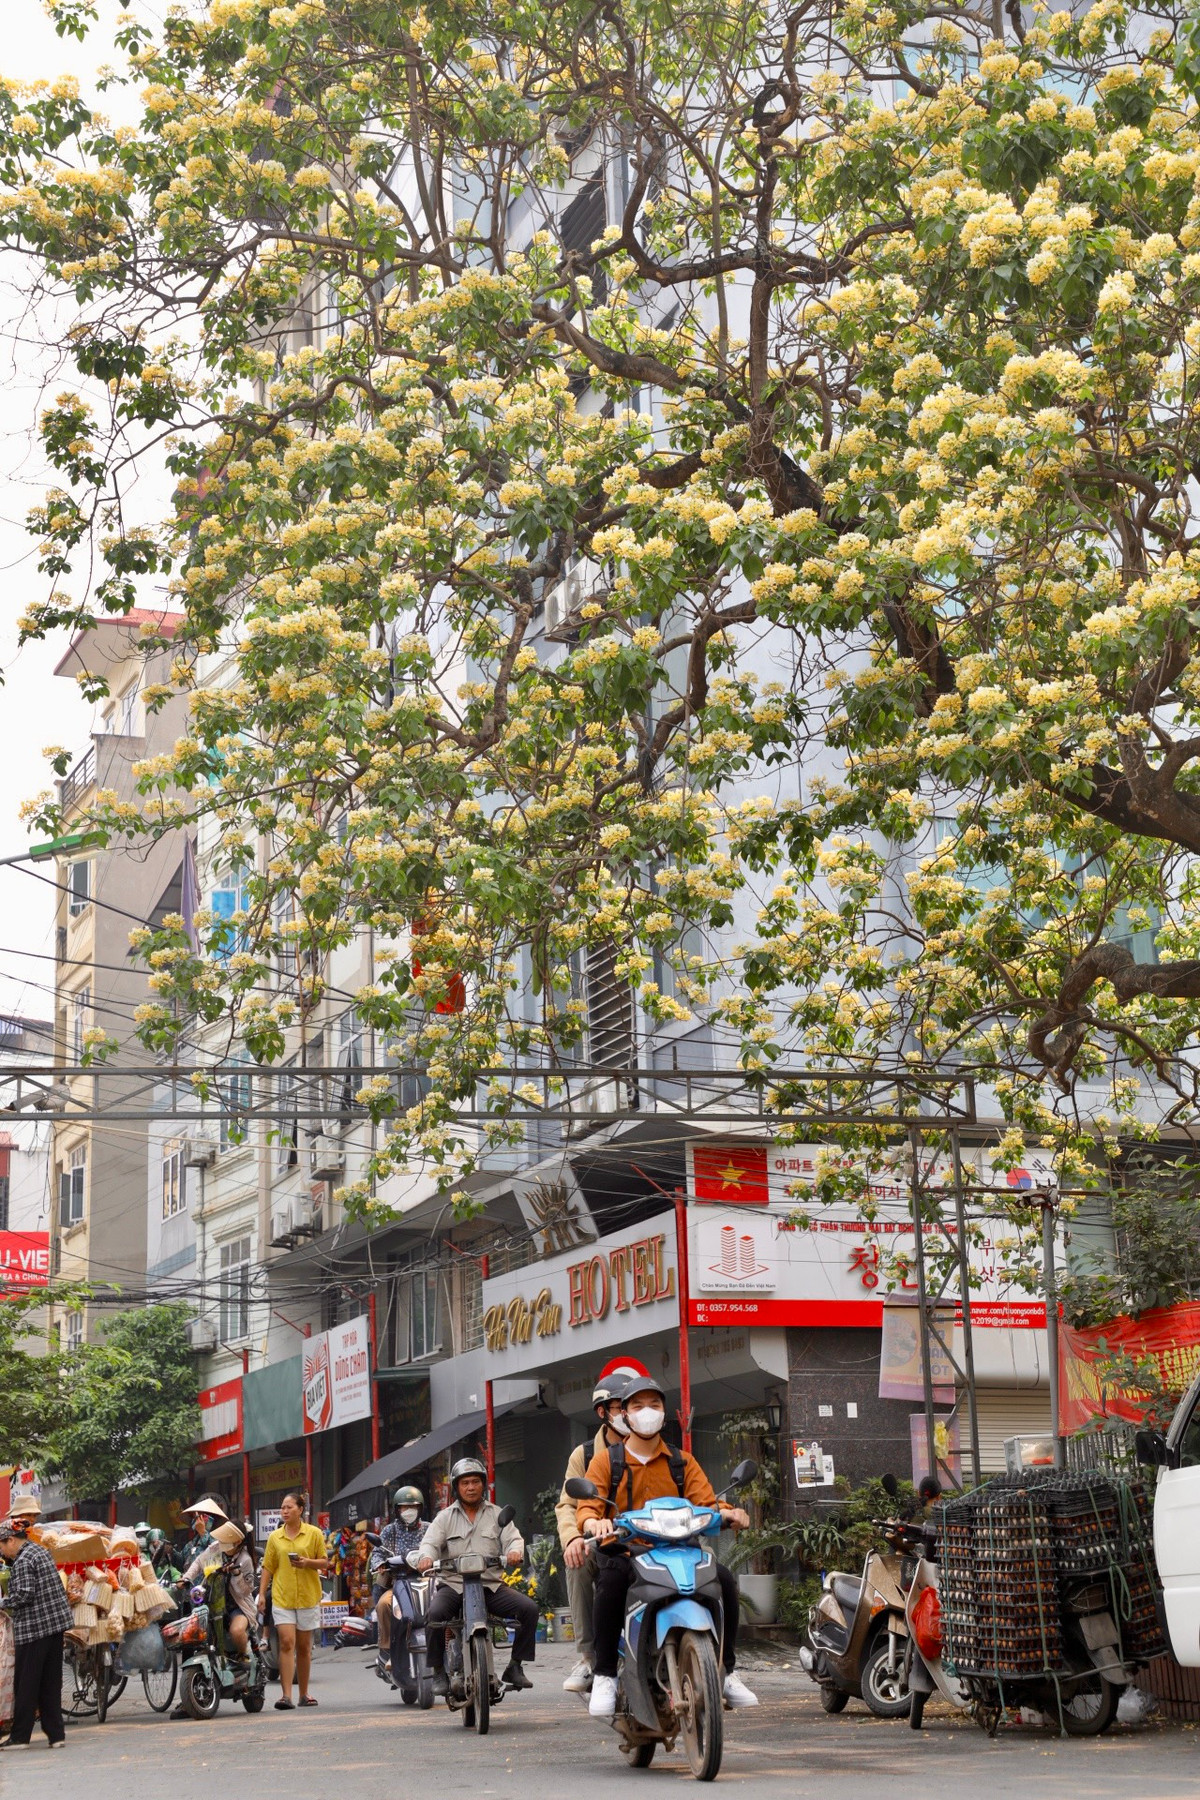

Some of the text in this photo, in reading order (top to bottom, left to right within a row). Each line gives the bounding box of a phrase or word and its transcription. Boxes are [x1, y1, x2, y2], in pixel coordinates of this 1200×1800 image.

[775, 1158, 815, 1173] 아파트
[566, 1233, 676, 1328] HOTEL
[709, 1304, 759, 1313] 0357.954.568
